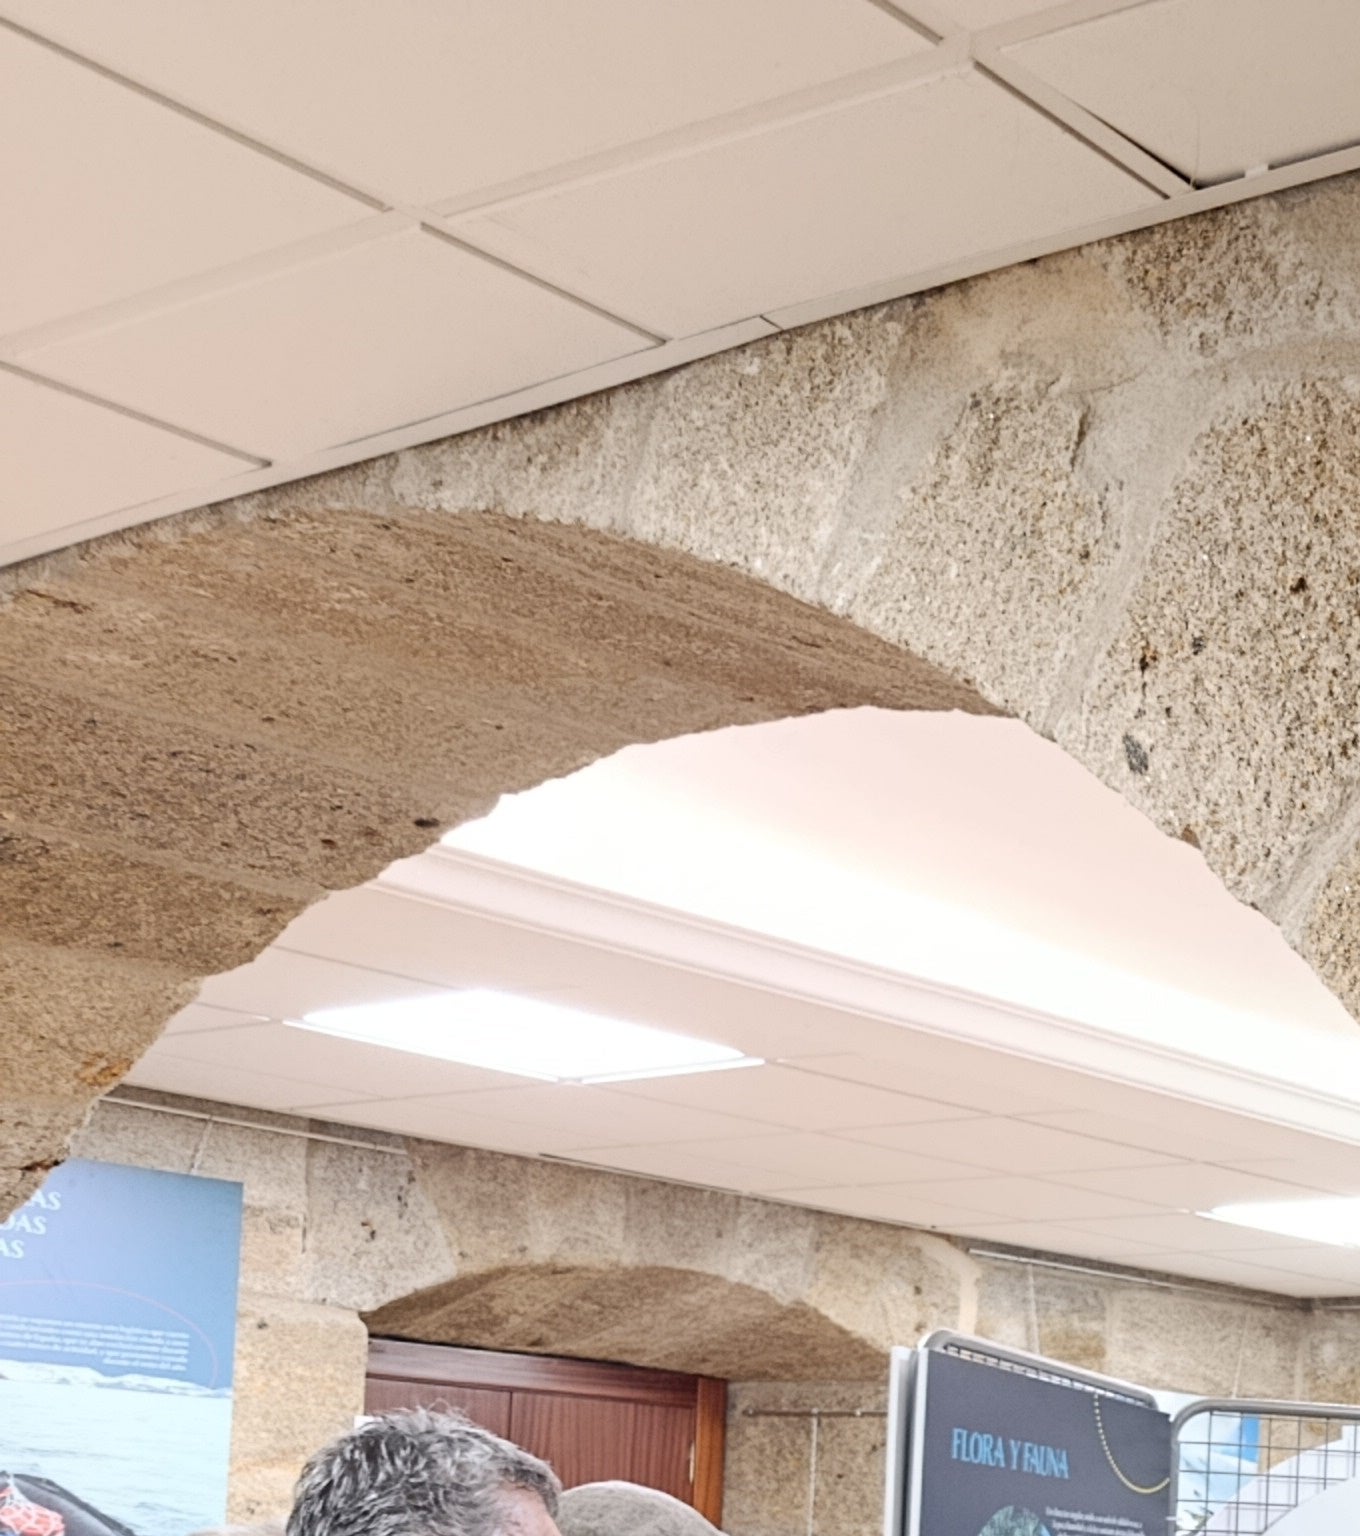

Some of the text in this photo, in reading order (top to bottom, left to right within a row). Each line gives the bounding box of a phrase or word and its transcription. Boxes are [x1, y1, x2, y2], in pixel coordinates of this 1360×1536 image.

[952, 1427, 1069, 1479] FLORA Y FAUNA
